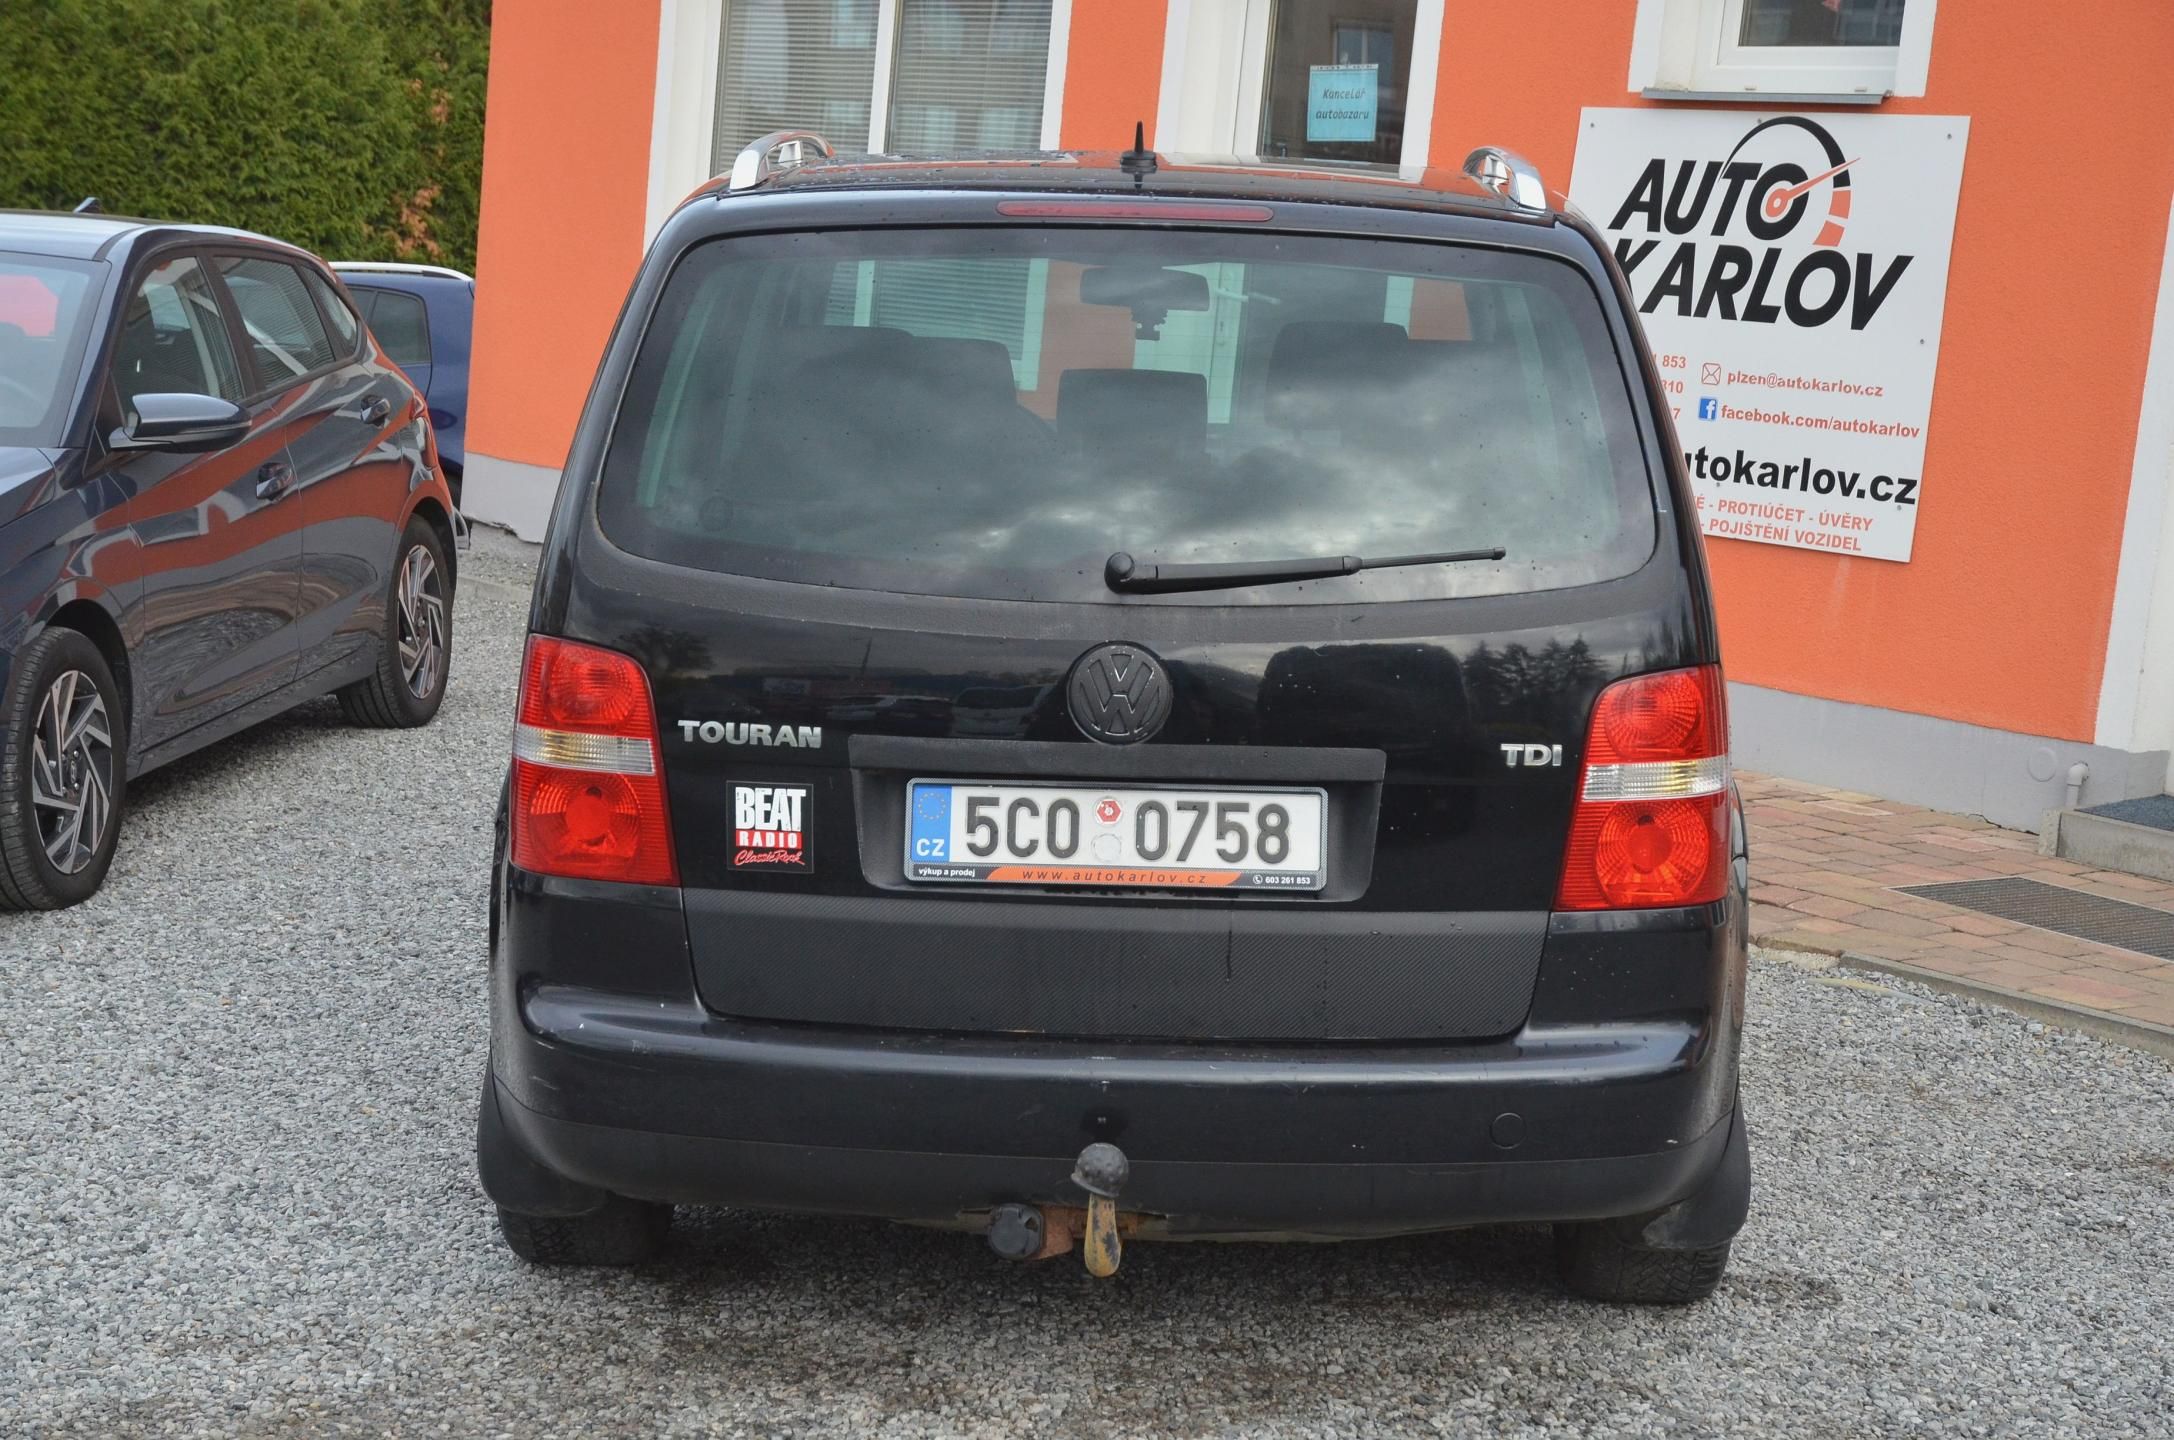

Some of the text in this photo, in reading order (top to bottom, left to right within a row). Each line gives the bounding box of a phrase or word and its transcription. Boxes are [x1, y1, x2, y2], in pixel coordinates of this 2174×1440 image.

[1315, 108, 1370, 121] autobazaru
[1607, 157, 1810, 241] AUTO
[1613, 237, 1915, 331] KARLOV
[1662, 354, 1687, 369] 853
[1726, 370, 1884, 398] plzen@autokarlov.cz
[1720, 404, 1921, 439] facebook.com/autokarlov
[1717, 498, 1806, 523] PROTIÚČET
[1818, 509, 1874, 532] ÚVĚRY
[1709, 518, 1791, 542] POJIŠTĚNÍ
[1794, 529, 1863, 552] VOZIDEL
[677, 719, 822, 749] TOURAN
[1500, 743, 1563, 767] TDI
[734, 786, 807, 832] BEAT
[738, 830, 799, 849] RADIO
[966, 795, 1291, 865] 5C0 0758
[915, 837, 946, 858] CZ
[918, 866, 976, 878] výkup a prodej
[1021, 869, 1208, 884] www.autokarlov.cz
[1265, 876, 1280, 885] 603
[1296, 876, 1311, 885] 853
